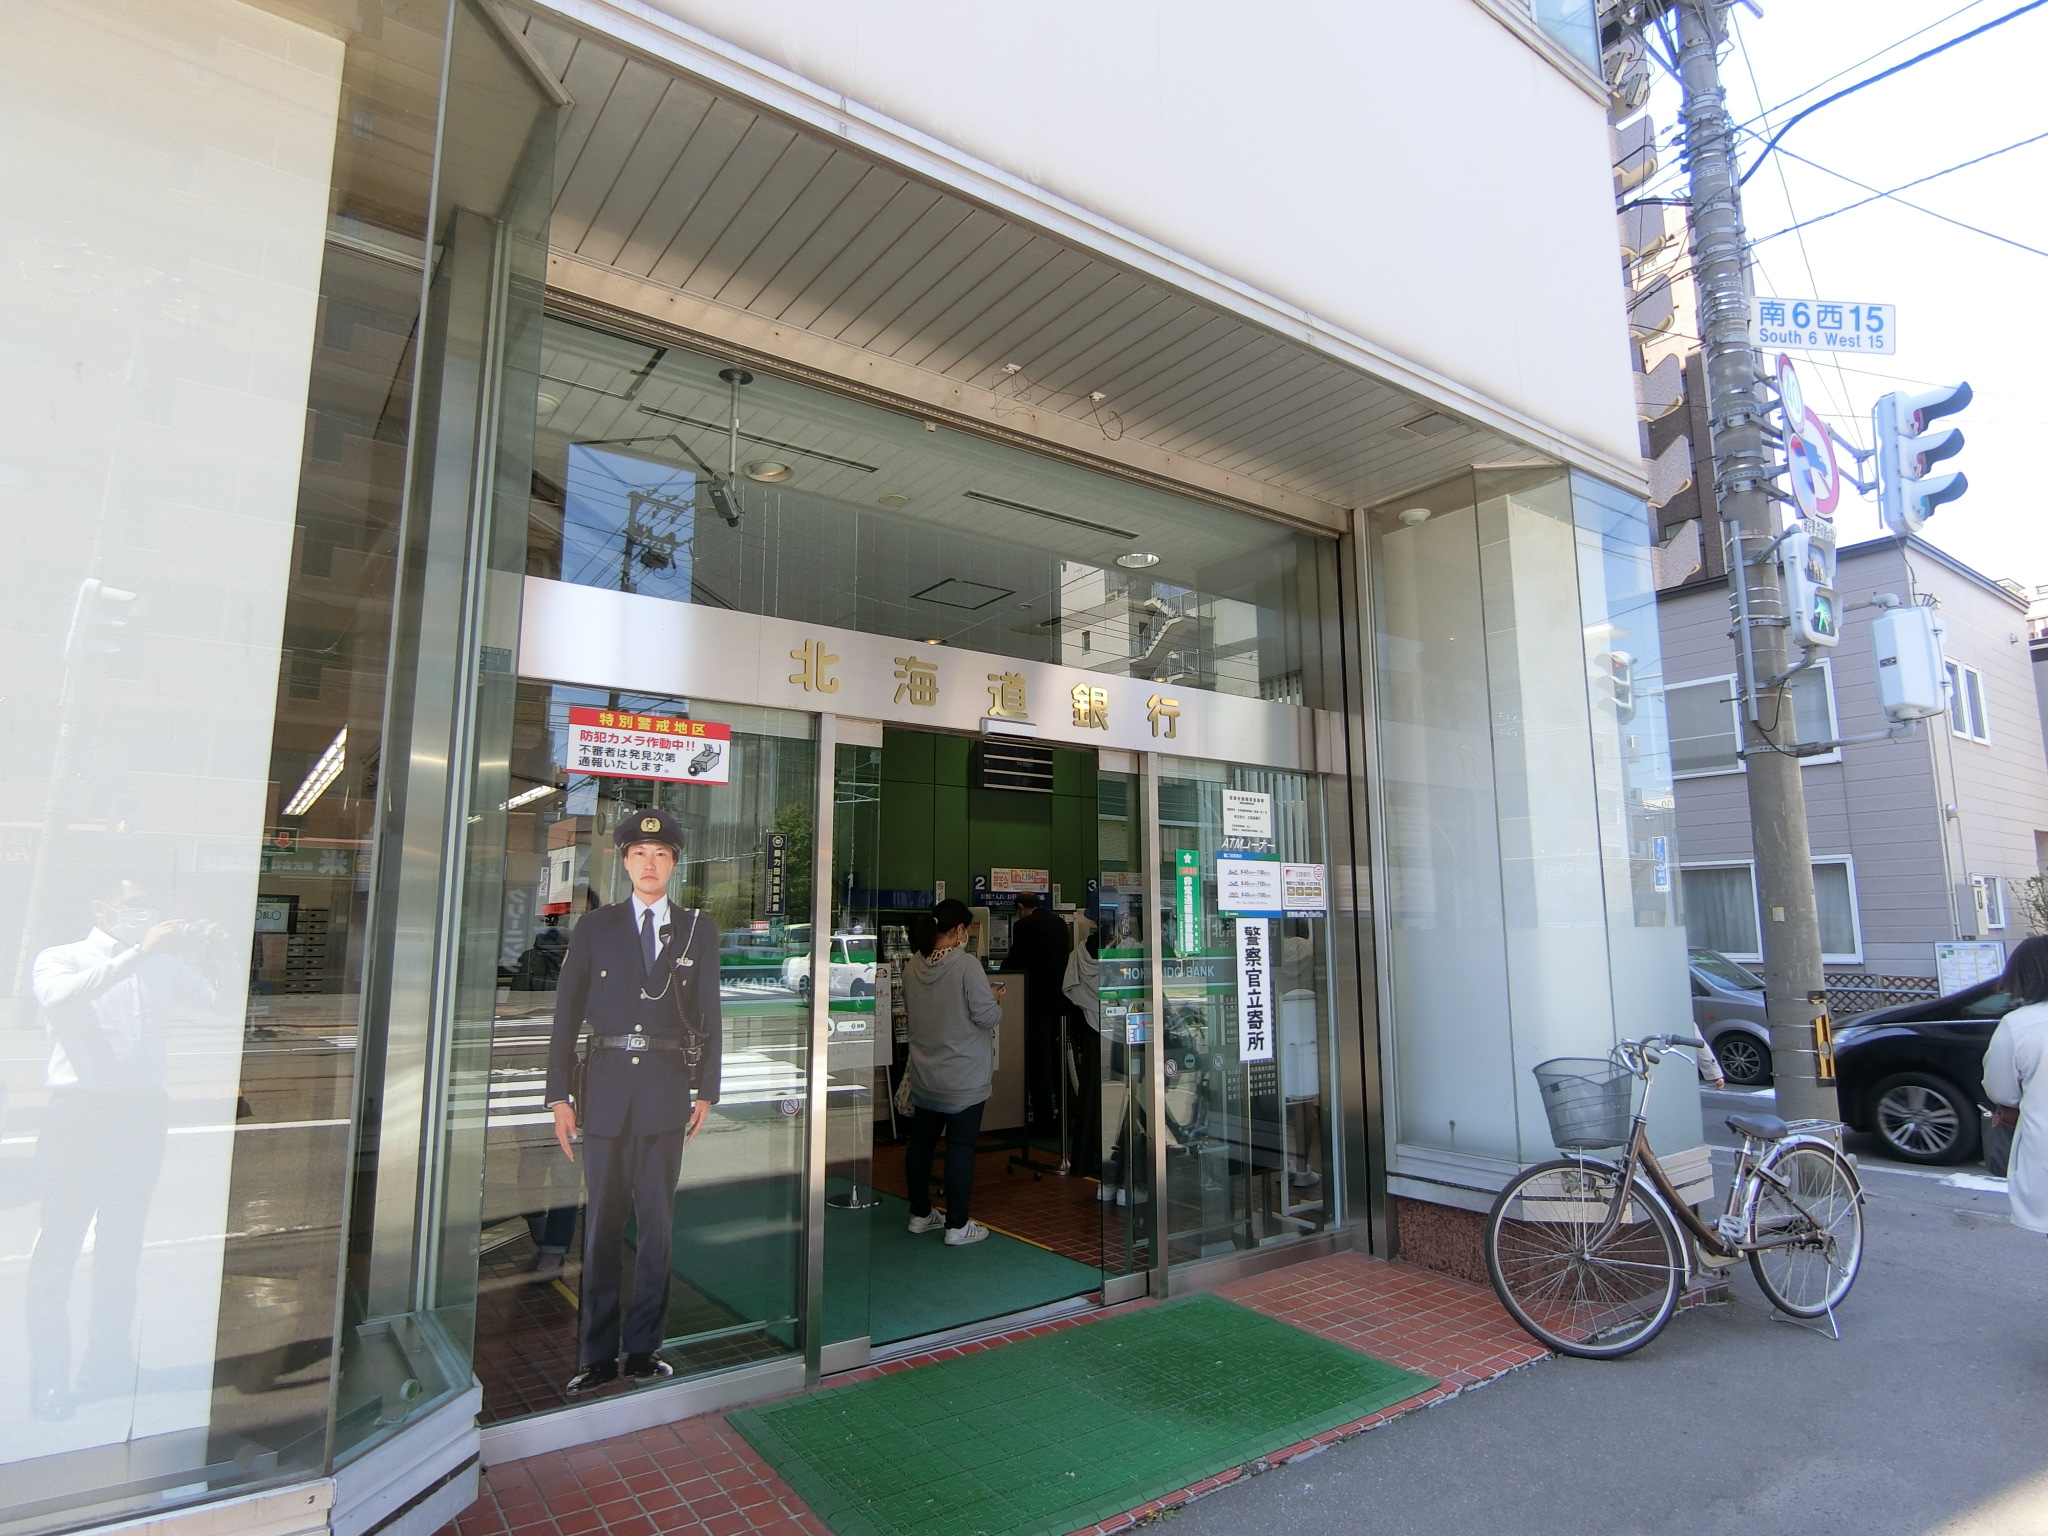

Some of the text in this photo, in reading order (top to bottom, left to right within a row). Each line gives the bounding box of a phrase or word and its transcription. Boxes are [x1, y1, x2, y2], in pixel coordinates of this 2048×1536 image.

[1759, 301, 1884, 332] 南6西15
[1759, 328, 1884, 349] South 6 West 15
[789, 638, 1181, 739] 北海道銀行
[600, 712, 706, 736] 特別警戒地区
[580, 729, 696, 752] 防犯カメラ作動中!!
[578, 744, 677, 763] 不審者は発見次第
[578, 755, 670, 773] 通報いたします。
[974, 876, 986, 890] 2
[1088, 879, 1097, 892] 3
[1186, 965, 1215, 978] BANK
[1244, 926, 1265, 1052] 警察官立寄所
